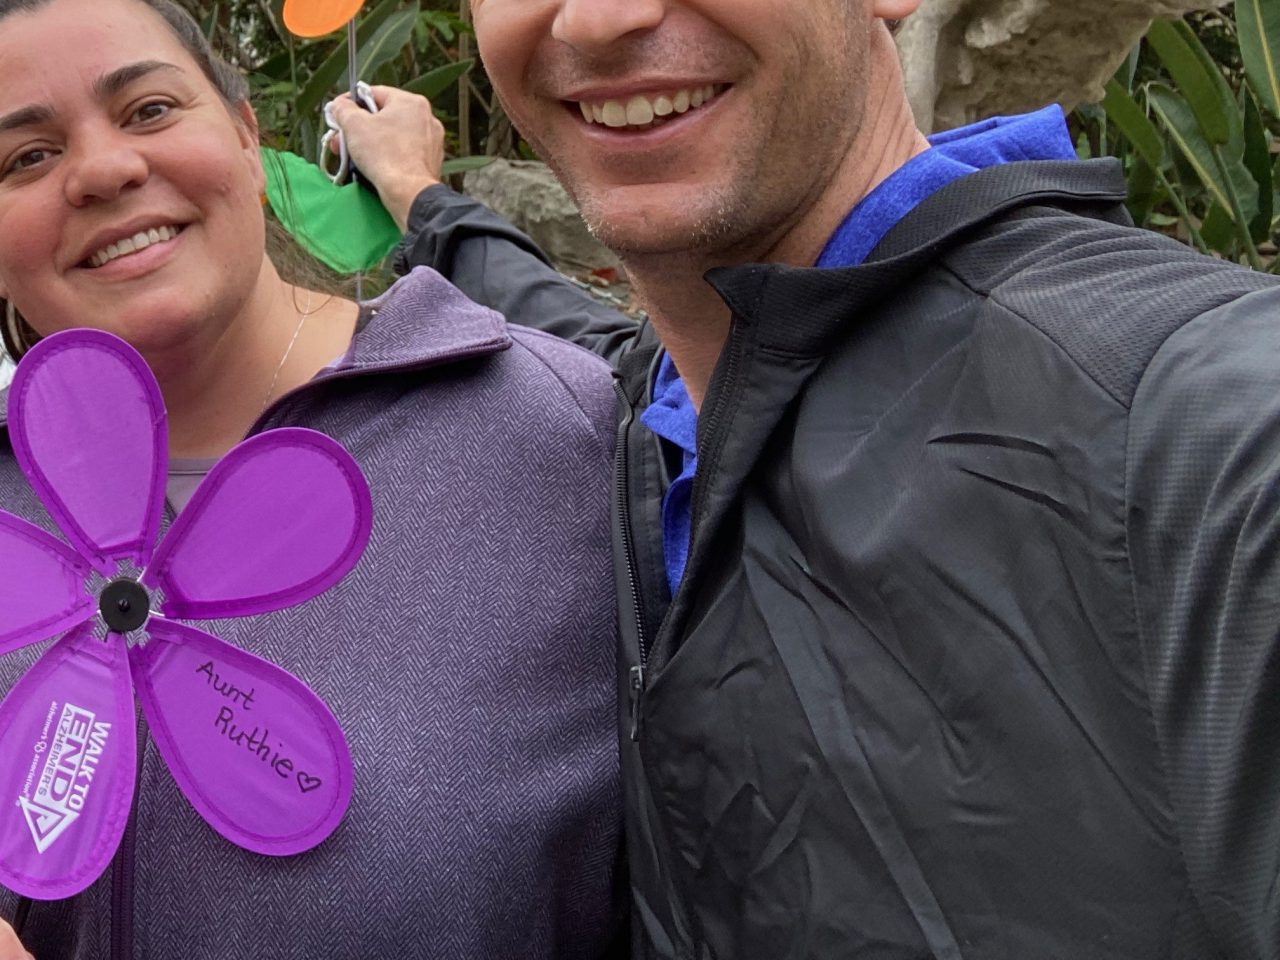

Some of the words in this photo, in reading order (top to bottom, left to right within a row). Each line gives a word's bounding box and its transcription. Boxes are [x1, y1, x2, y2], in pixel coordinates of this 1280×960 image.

[195, 660, 255, 711] Aunt
[38, 707, 73, 797] ALZHEIMER'S
[50, 711, 92, 802] END
[78, 721, 112, 783] WALK
[214, 705, 294, 779] Ruthie
[68, 783, 91, 811] TO
